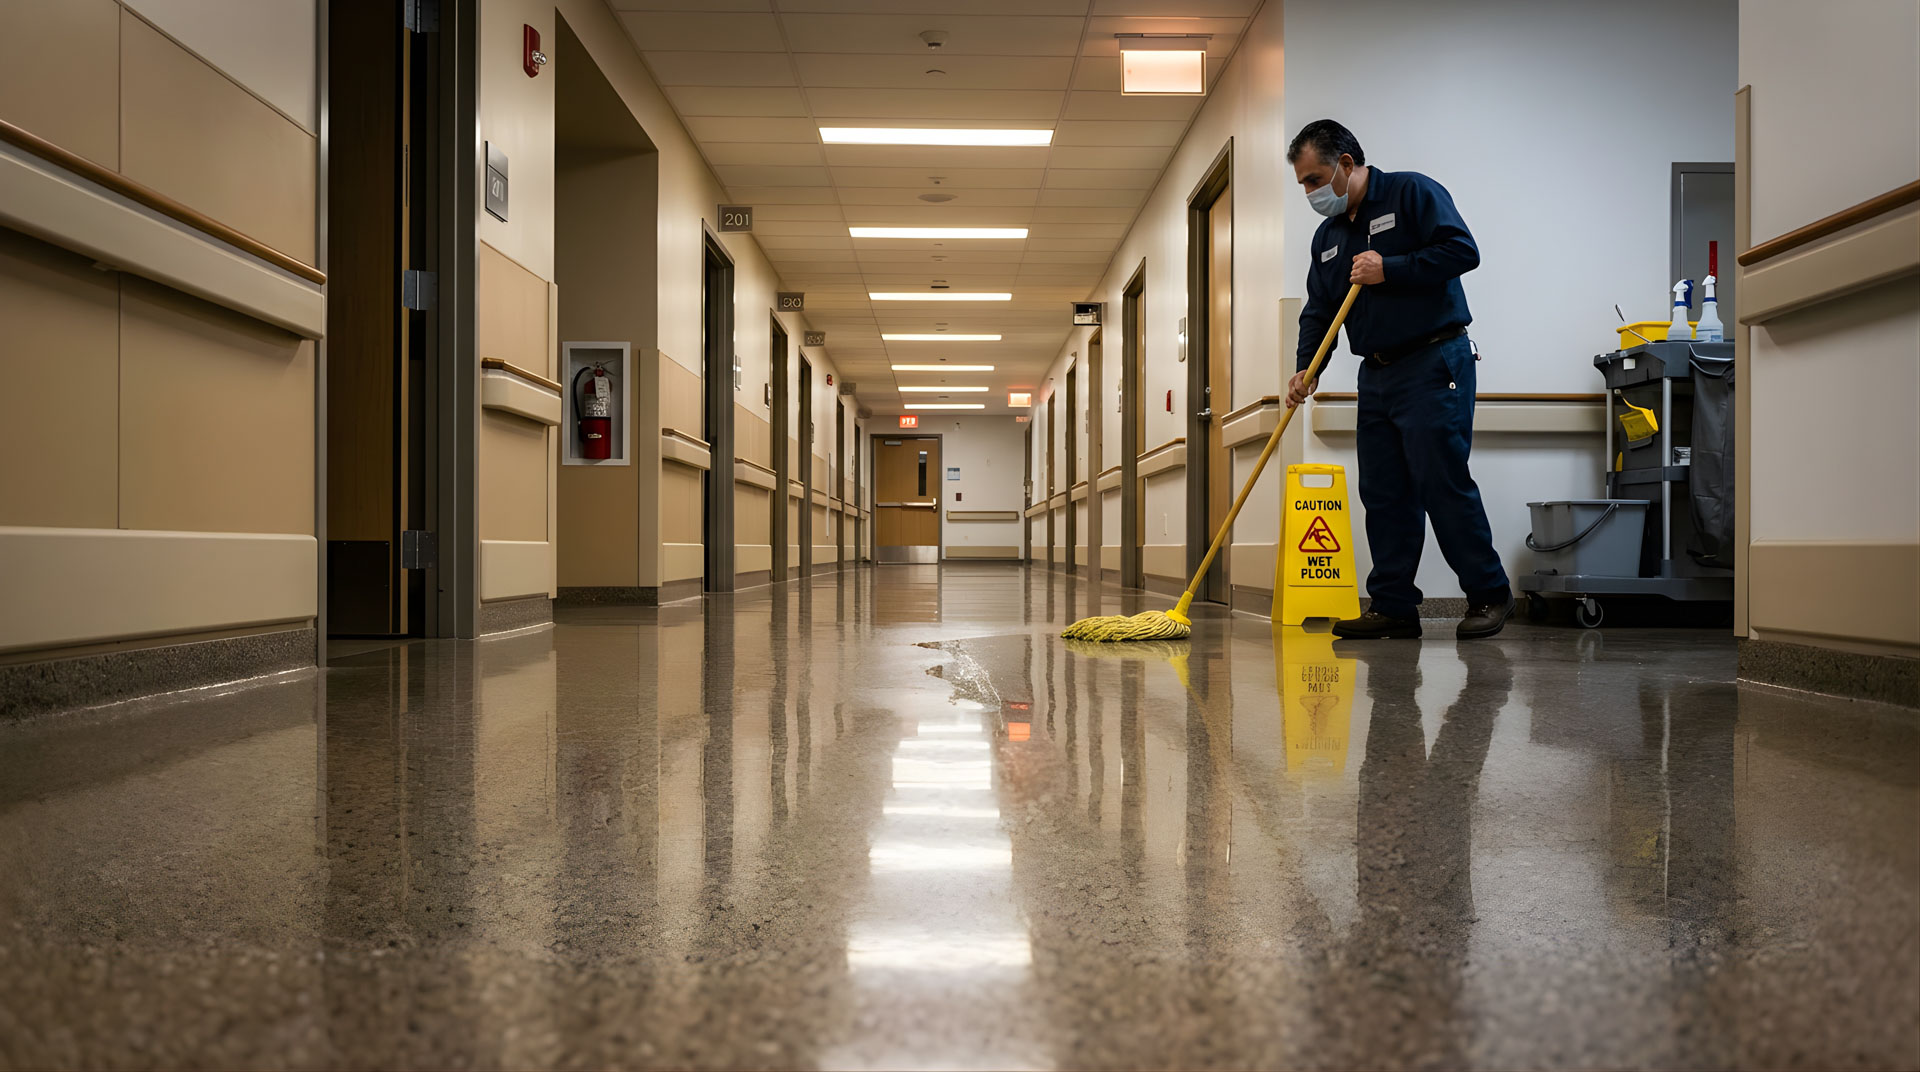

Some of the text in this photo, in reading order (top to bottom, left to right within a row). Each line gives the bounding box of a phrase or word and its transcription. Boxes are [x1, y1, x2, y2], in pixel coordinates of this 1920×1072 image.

[725, 213, 749, 226] 201
[1295, 500, 1342, 511] CAUTION
[1307, 556, 1333, 567] WET
[1301, 568, 1340, 579] PLOON
